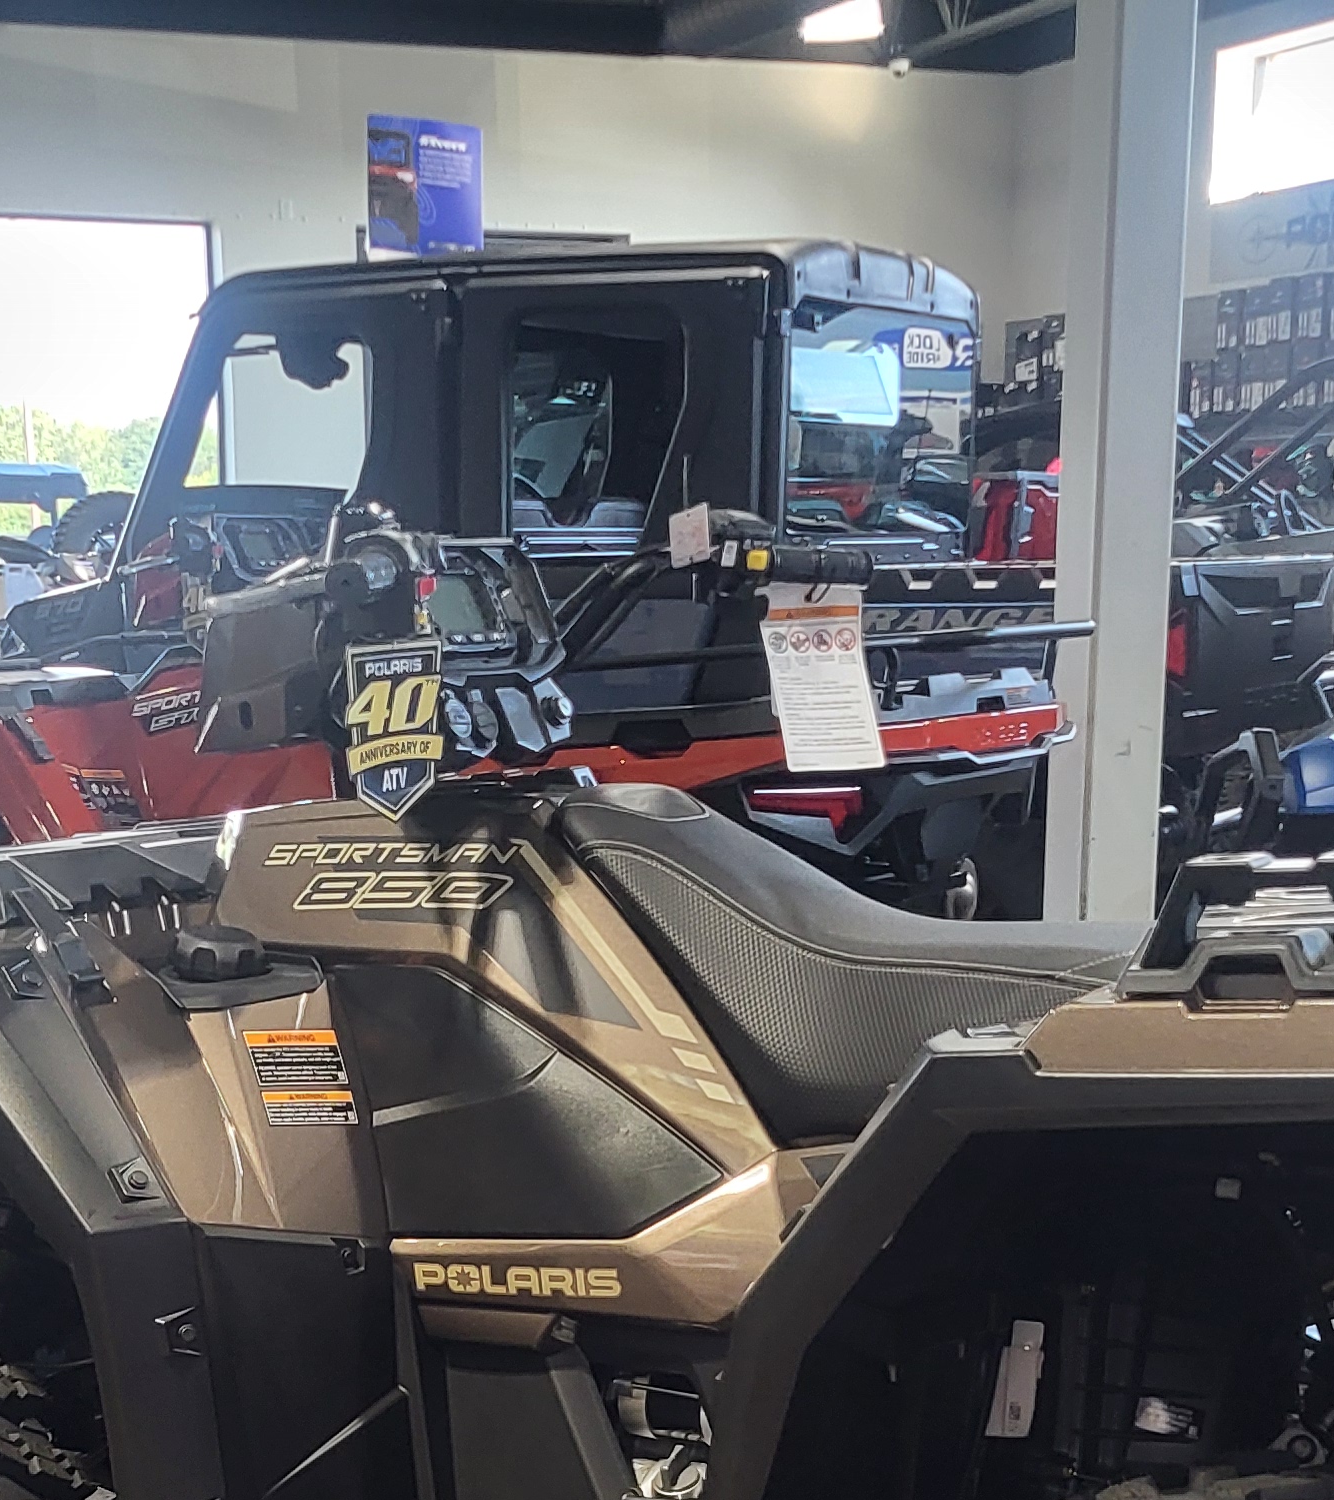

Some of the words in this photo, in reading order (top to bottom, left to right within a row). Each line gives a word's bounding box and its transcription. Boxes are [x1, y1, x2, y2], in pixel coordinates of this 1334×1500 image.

[364, 658, 424, 678] POLARIS
[359, 742, 417, 764] ANNIVERSARY
[419, 741, 432, 755] OF
[382, 766, 408, 793] ATV
[263, 842, 521, 867] SPORTSMAN
[292, 871, 514, 911] 850
[275, 1033, 316, 1043] WARNING
[412, 1262, 622, 1298] POLARIS
